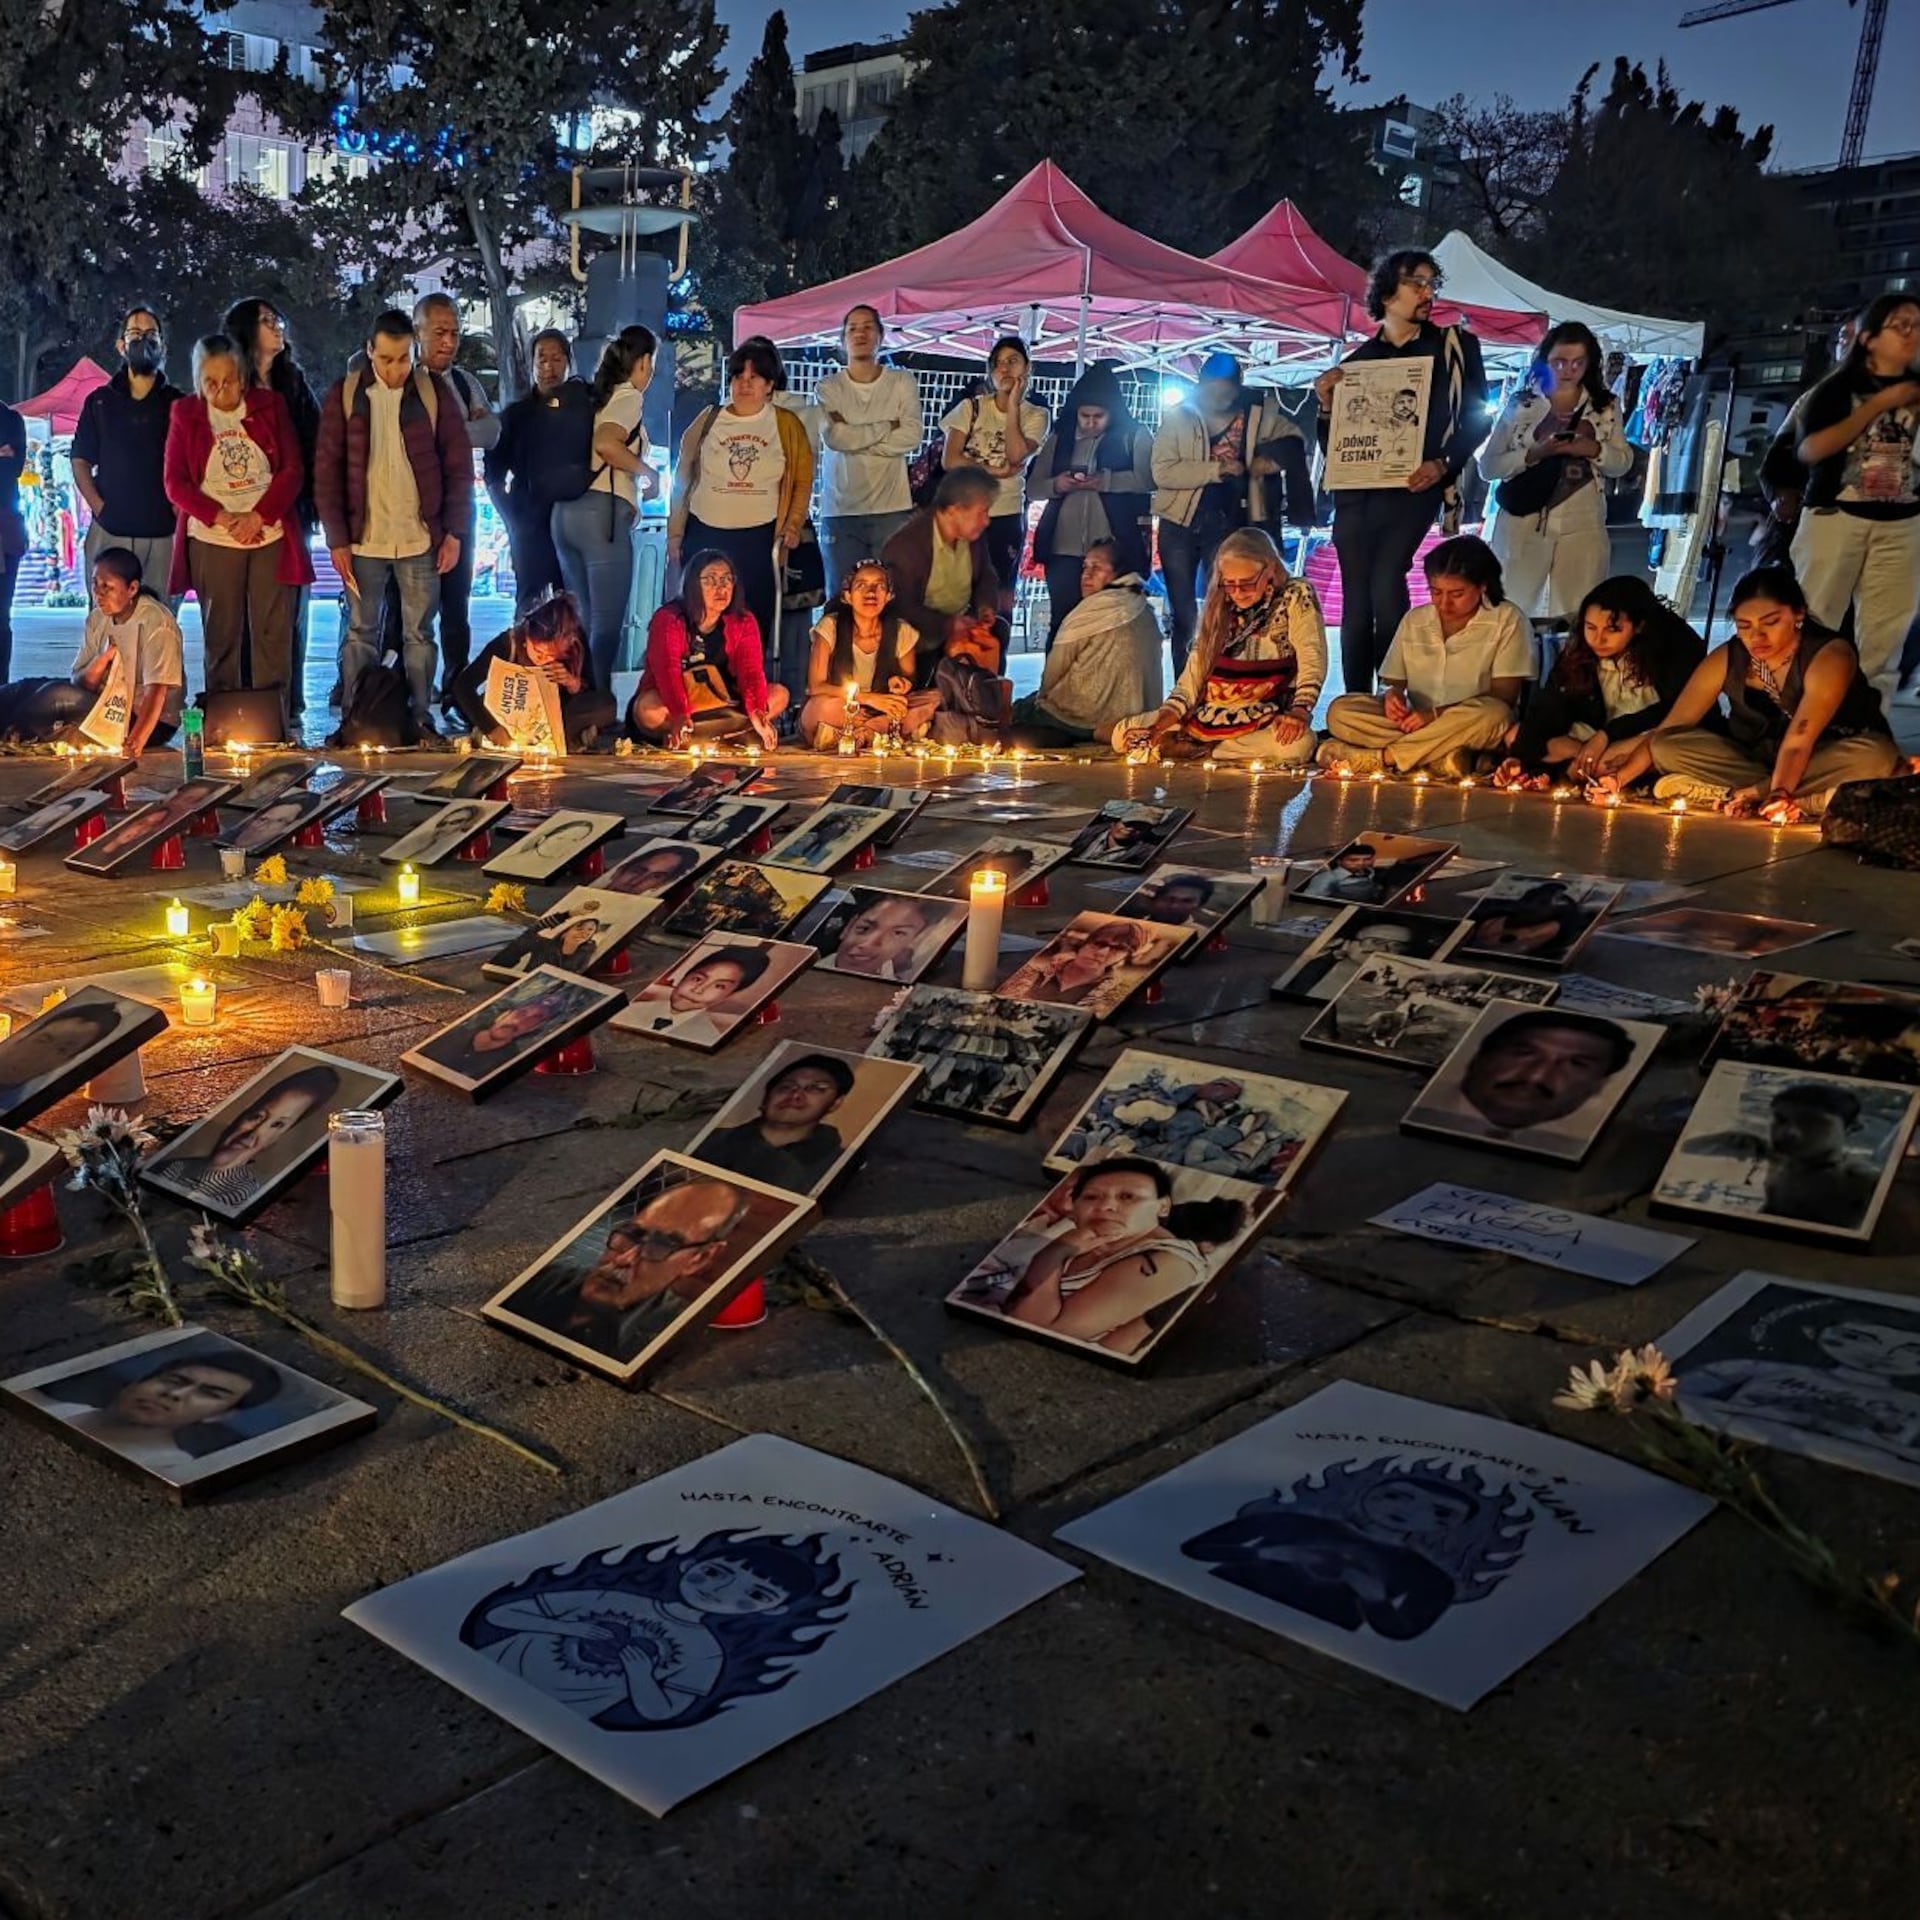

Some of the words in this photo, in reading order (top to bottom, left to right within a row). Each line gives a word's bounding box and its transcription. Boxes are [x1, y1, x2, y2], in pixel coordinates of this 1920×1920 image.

[1335, 434, 1379, 452] ¿DÓNDE
[1295, 1432, 1369, 1442] HASTA
[1378, 1435, 1540, 1475] ENCONTRARTE
[681, 1491, 753, 1502] HASTA
[763, 1495, 914, 1545] ENCONTRARTE
[1519, 1481, 1595, 1534] JUAN
[870, 1551, 930, 1610] ADRIÁN
